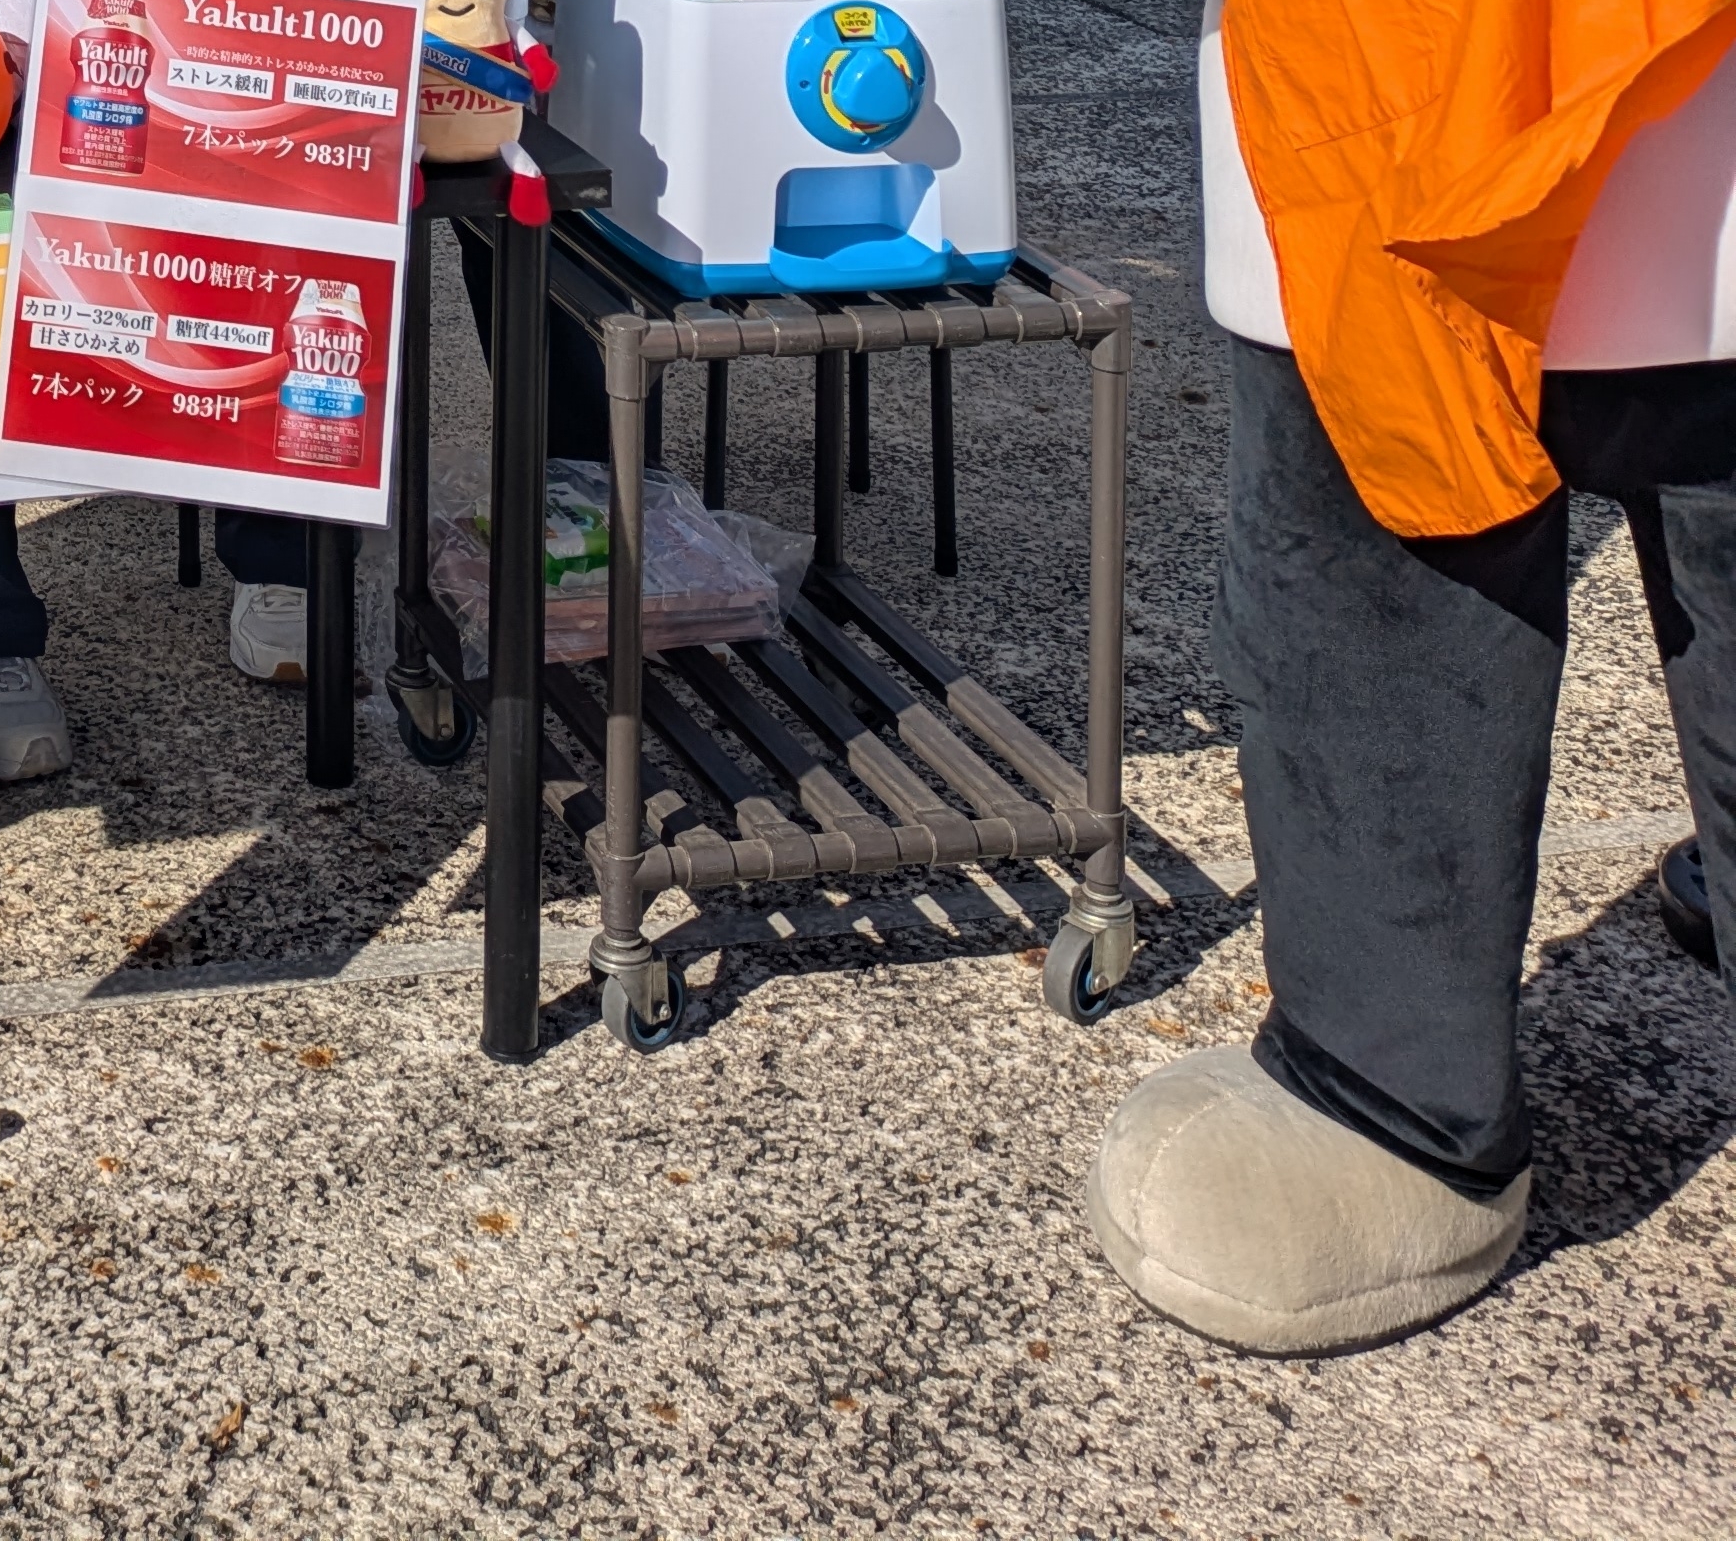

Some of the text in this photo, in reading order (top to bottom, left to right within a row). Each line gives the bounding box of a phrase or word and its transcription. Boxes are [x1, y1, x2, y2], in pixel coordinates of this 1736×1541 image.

[78, 37, 150, 68] Yakult
[77, 59, 146, 90] 1000
[169, 66, 270, 95] ストレス緩和
[292, 80, 395, 112] 睡眠の質向上
[182, 123, 296, 161] 7本パック
[303, 141, 373, 173] 983円
[35, 236, 302, 296] Yakult1000糖質オフ
[24, 299, 155, 333] カロリー32%off
[38, 326, 140, 356] 甘さひかえめ
[175, 318, 270, 348] 糖質44%off
[291, 324, 364, 354] Yakult
[291, 347, 361, 377] 1000
[30, 372, 240, 424] 7本パック 983円
